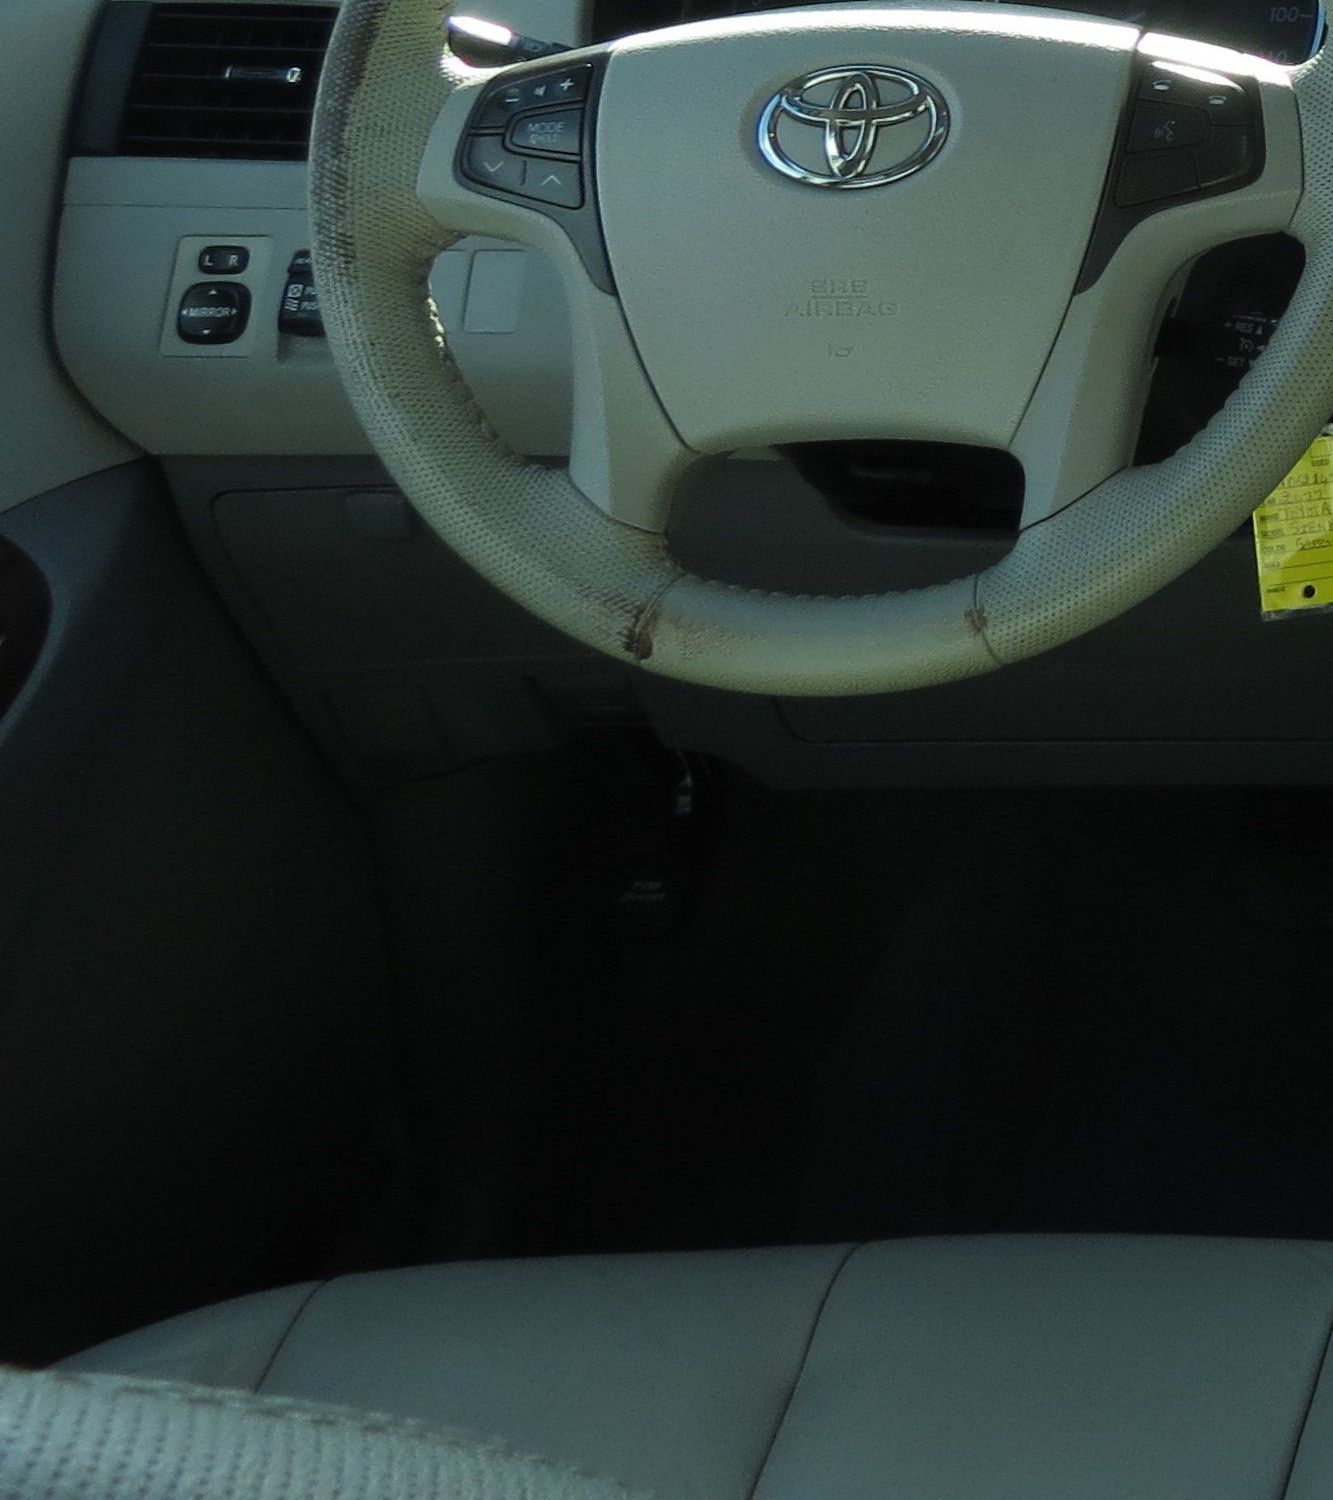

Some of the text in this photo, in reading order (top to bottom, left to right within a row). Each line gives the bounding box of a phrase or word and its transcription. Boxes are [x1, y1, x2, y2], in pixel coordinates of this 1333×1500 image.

[1269, 6, 1300, 22] 100
[204, 254, 214, 267] L
[229, 254, 240, 267] R
[188, 306, 232, 318] MIRROR
[783, 299, 903, 317] AIRBAG
